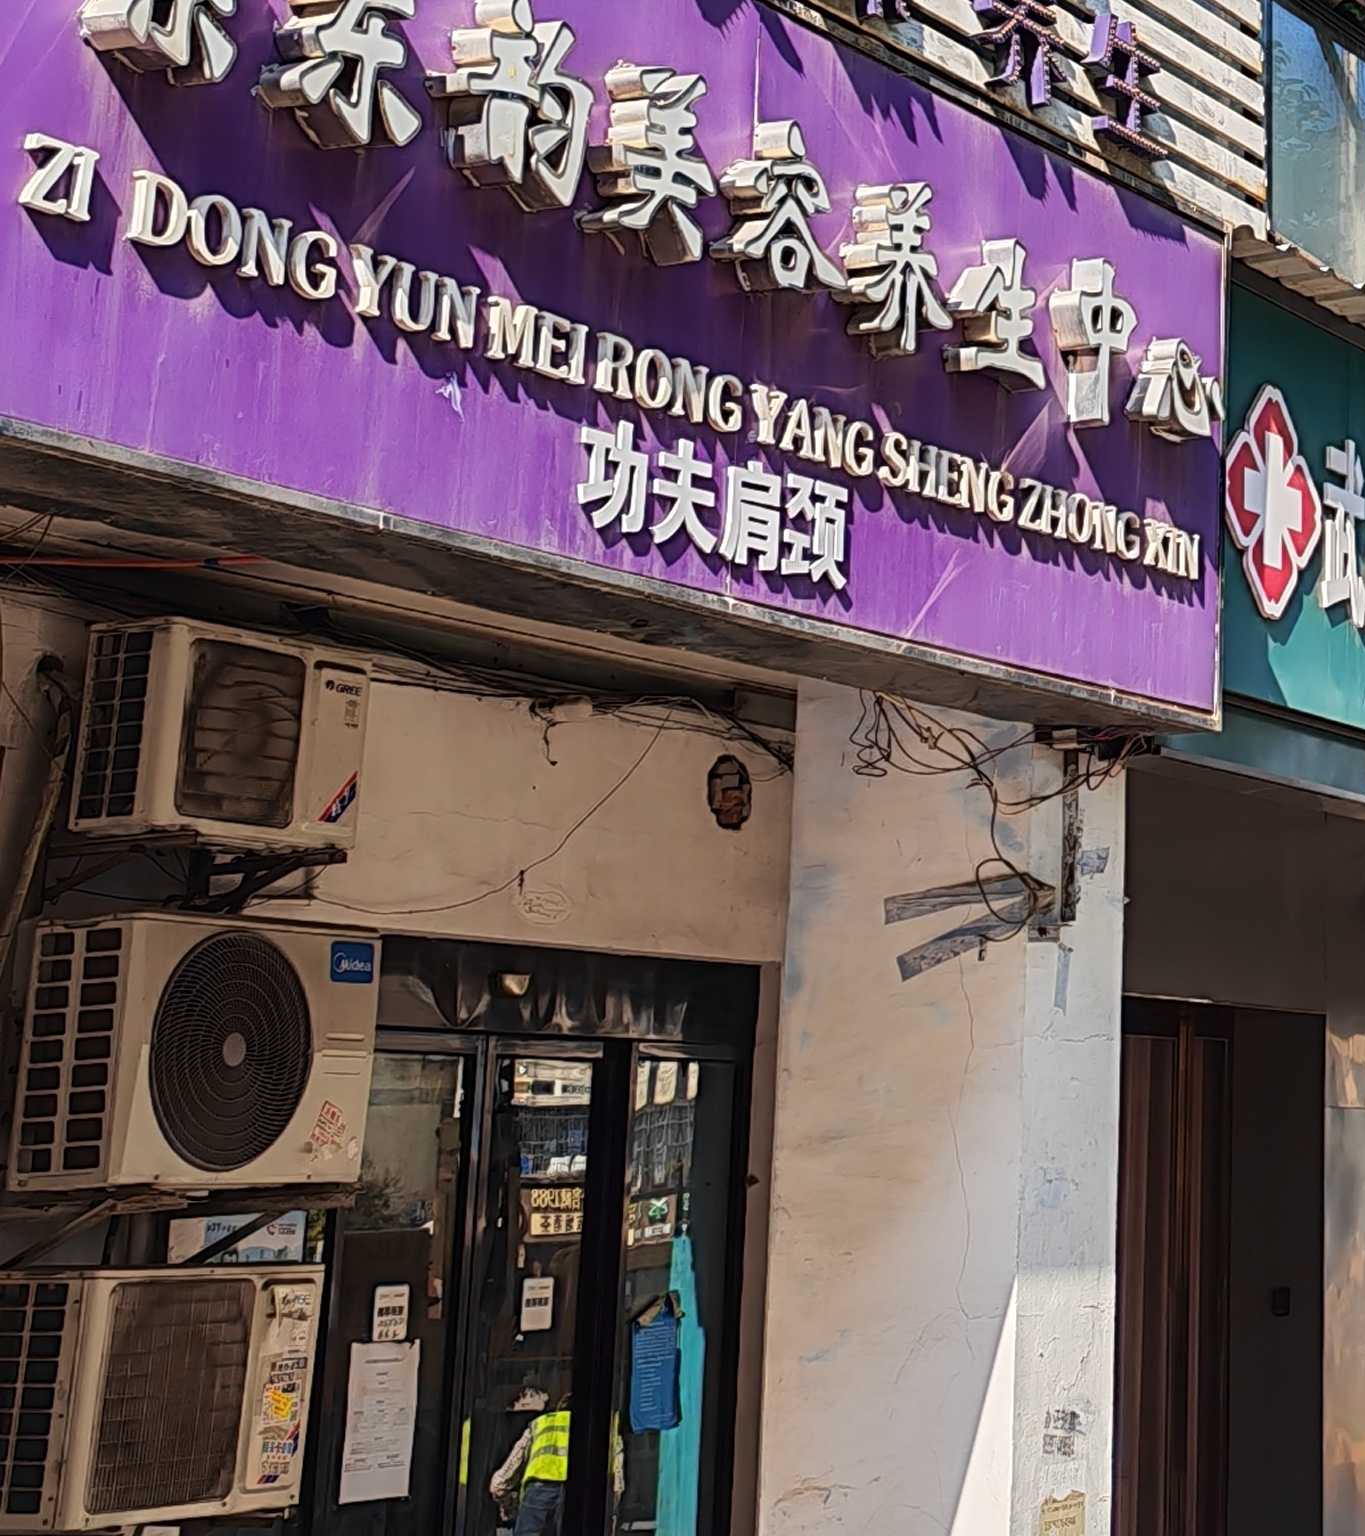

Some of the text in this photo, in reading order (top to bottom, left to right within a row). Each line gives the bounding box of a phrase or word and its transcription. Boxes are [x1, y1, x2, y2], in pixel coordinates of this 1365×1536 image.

[18, 132, 1201, 581] ZI DONG YUN MEI RONG YANG SHENG ZHONG XIN
[575, 420, 853, 592] 功夫肩颈
[335, 683, 363, 697] GREE
[334, 951, 371, 973] Midea
